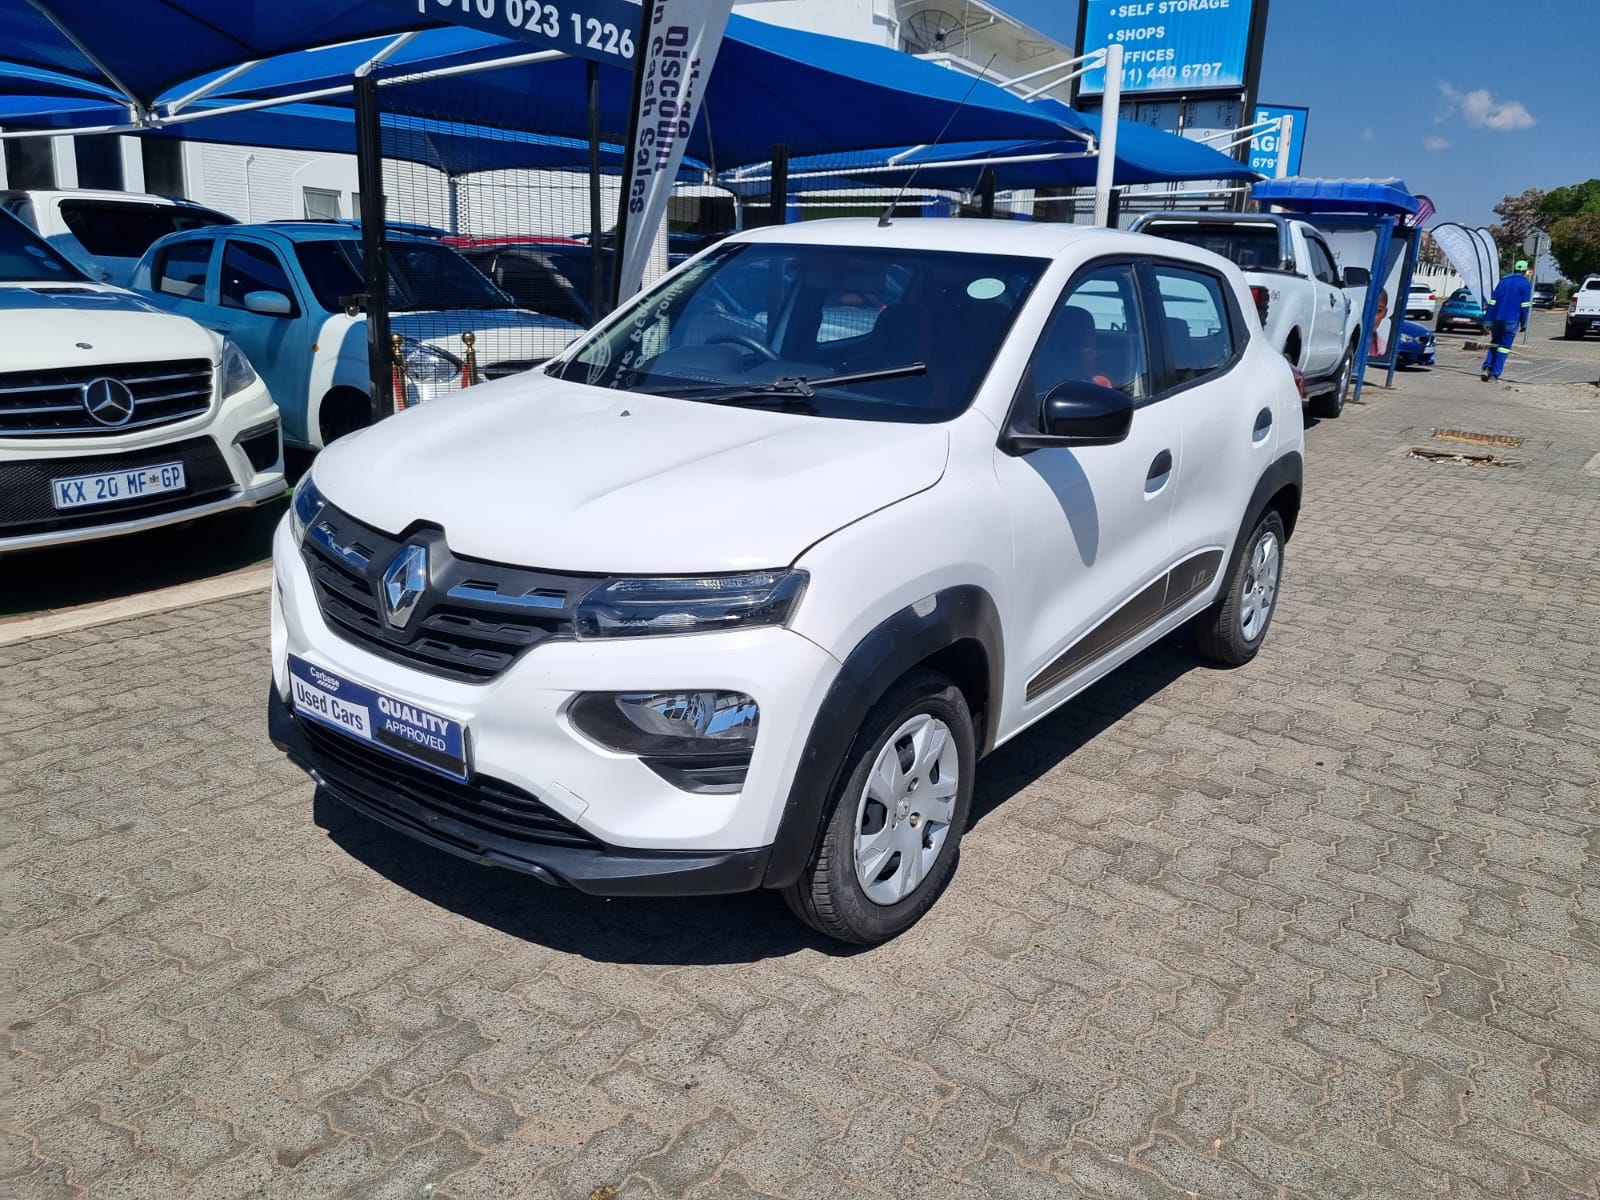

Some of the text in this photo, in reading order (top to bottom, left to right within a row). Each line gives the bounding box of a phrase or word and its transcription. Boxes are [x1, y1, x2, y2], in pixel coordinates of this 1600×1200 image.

[1118, 0, 1230, 18] SELF STORAGE
[506, 0, 560, 38] 023
[570, 12, 635, 59] 1226
[1115, 26, 1166, 42] SHOPS
[1123, 48, 1175, 64] FFICES
[1147, 65, 1177, 80] 440
[1181, 62, 1223, 79] 6797
[629, 127, 656, 214] Sales
[60, 467, 180, 504] KX 20 MF GP
[310, 666, 341, 689] Carbase
[294, 682, 364, 731] Used Cars
[377, 697, 449, 736] QUALITY
[385, 719, 447, 752] APPROVED
